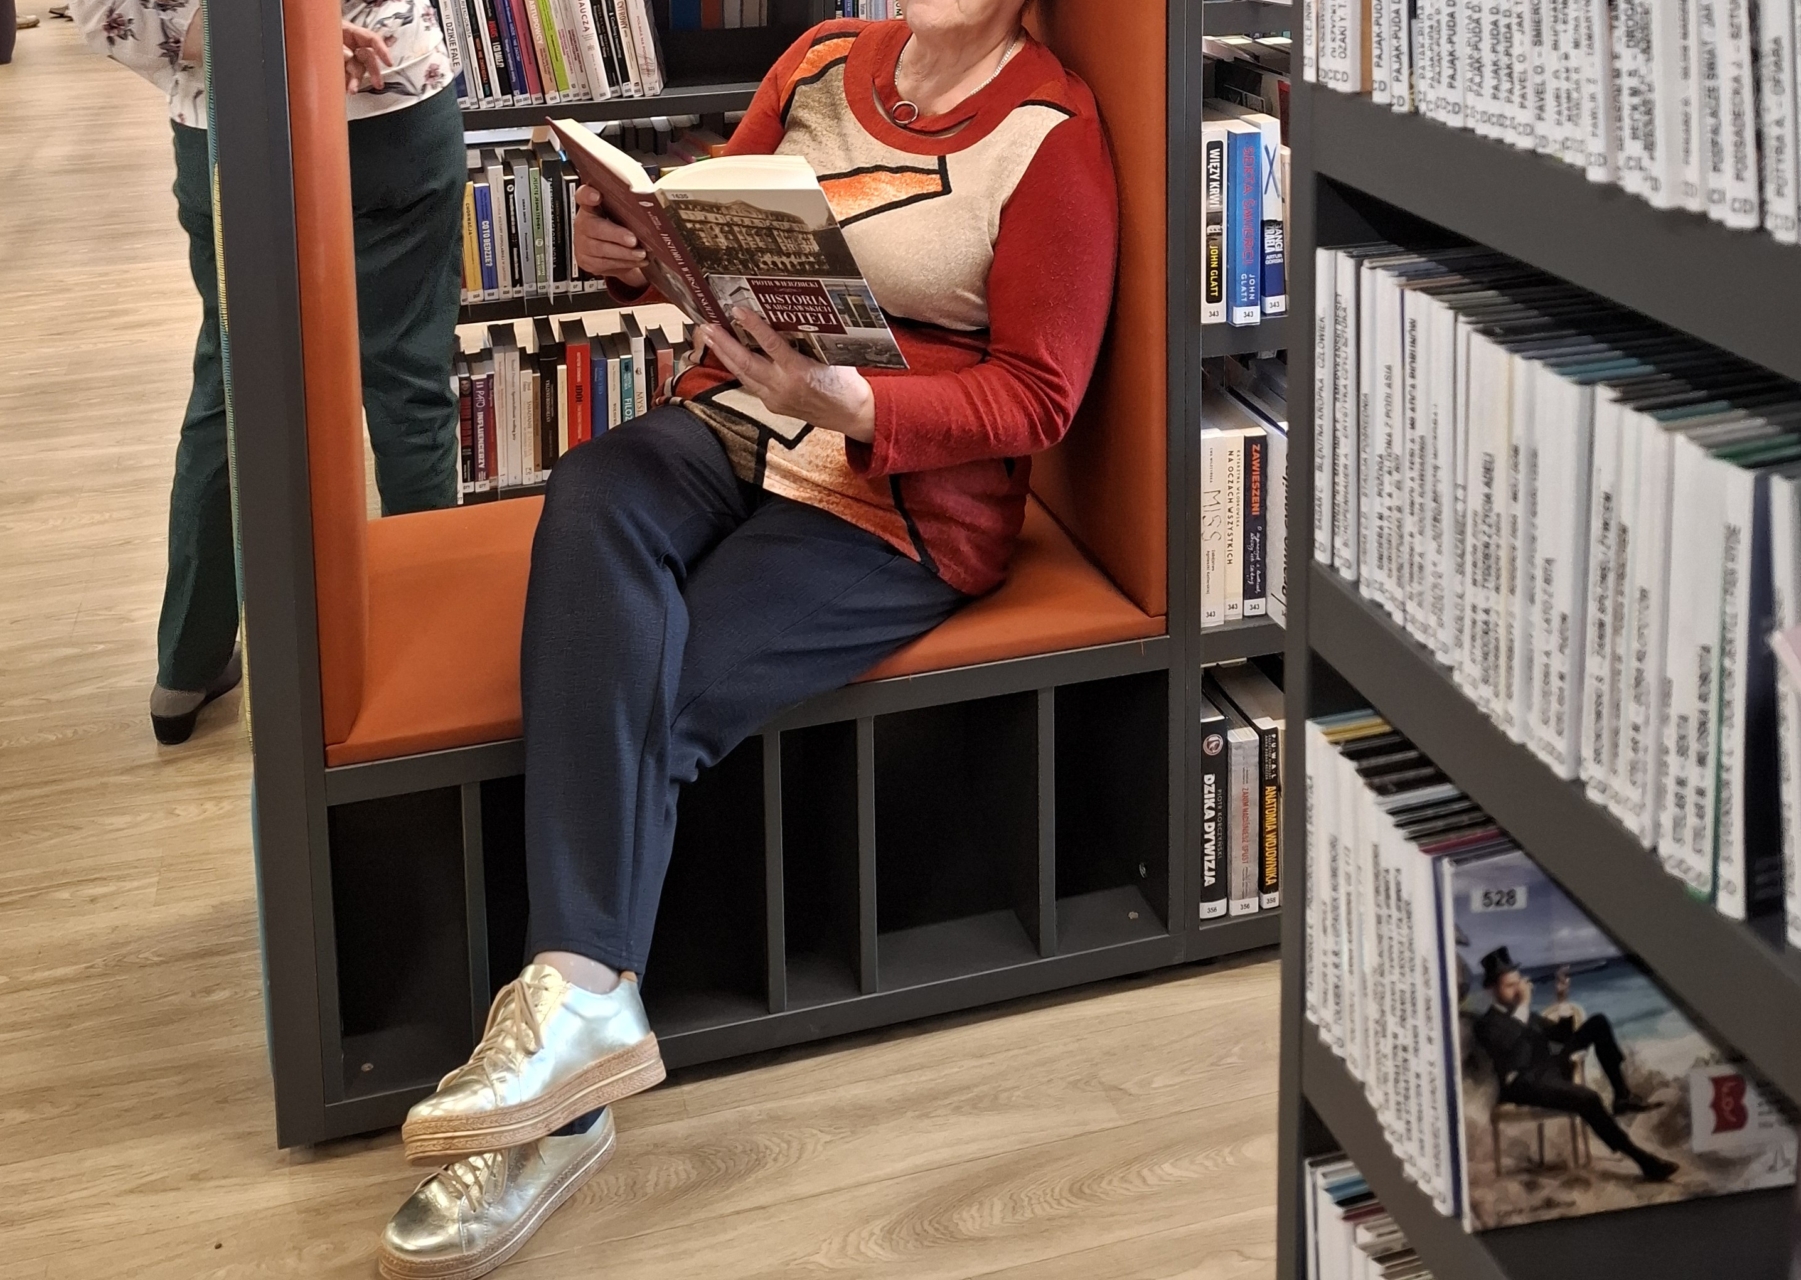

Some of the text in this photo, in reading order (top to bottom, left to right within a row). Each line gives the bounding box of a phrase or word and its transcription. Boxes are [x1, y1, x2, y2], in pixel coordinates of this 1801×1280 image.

[445, 22, 461, 67] DZIKIE FALE
[1338, 26, 1347, 59] OZAKI
[1391, 7, 1403, 82] PAJĄK-PUDA
[1514, 10, 1525, 36] JAK
[1446, 10, 1459, 89] PAJĄK-PUDA
[1207, 148, 1220, 208] WIĘZY KRWI
[1243, 147, 1254, 194] SEKTA
[1208, 245, 1218, 297] JOHN GLATT
[758, 293, 828, 306] HISTORIA
[763, 303, 832, 313] WARSZAWSKICH
[769, 311, 839, 325] HOTELI
[1270, 301, 1280, 309] 343
[477, 411, 485, 468] INFLUENCERZY
[1227, 450, 1234, 462] NA
[1251, 444, 1260, 515] ZAWIESZENI
[1201, 490, 1222, 541] MISS
[1204, 774, 1215, 887] DZIKA DYWIZJA
[1265, 786, 1276, 885] ANATOMIA WOJOWNIKA
[1483, 888, 1517, 907] 528
